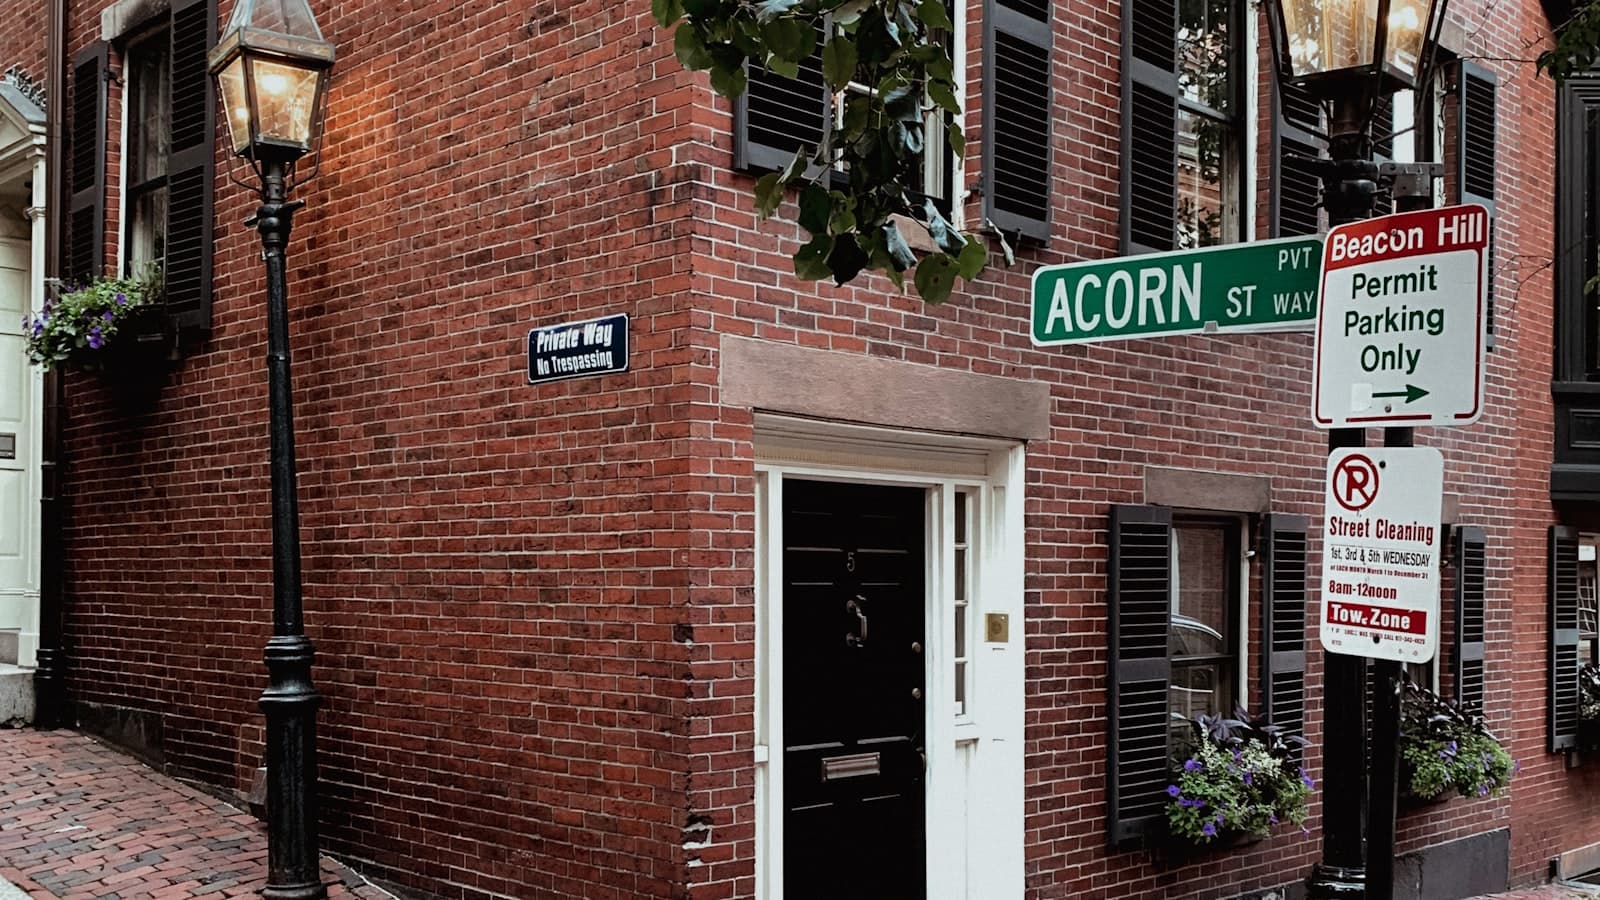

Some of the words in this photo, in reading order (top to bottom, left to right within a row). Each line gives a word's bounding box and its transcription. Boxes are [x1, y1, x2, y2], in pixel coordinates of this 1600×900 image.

[1331, 227, 1423, 262] Beacon
[1437, 212, 1483, 246] Hill
[1278, 247, 1313, 271] PVT
[1352, 264, 1438, 299] Permit
[1044, 262, 1202, 334] ACORN
[1226, 285, 1257, 318] ST
[1273, 290, 1315, 315] WAY
[1344, 304, 1445, 337] Parking
[536, 327, 580, 354] Private
[583, 323, 613, 347] Way
[536, 358, 550, 375] No
[551, 349, 613, 373] Trespassing
[1360, 343, 1421, 375] Only
[1329, 516, 1370, 538] Street
[1376, 518, 1434, 546] Cleaning
[847, 551, 855, 572] 5
[1345, 547, 1357, 561] 3rd
[1368, 549, 1381, 563] 5th
[1383, 550, 1431, 567] WEDNESDAY
[1329, 580, 1397, 600] 8am-12noon
[1331, 604, 1363, 624] Tow
[1369, 608, 1411, 630] Zone
